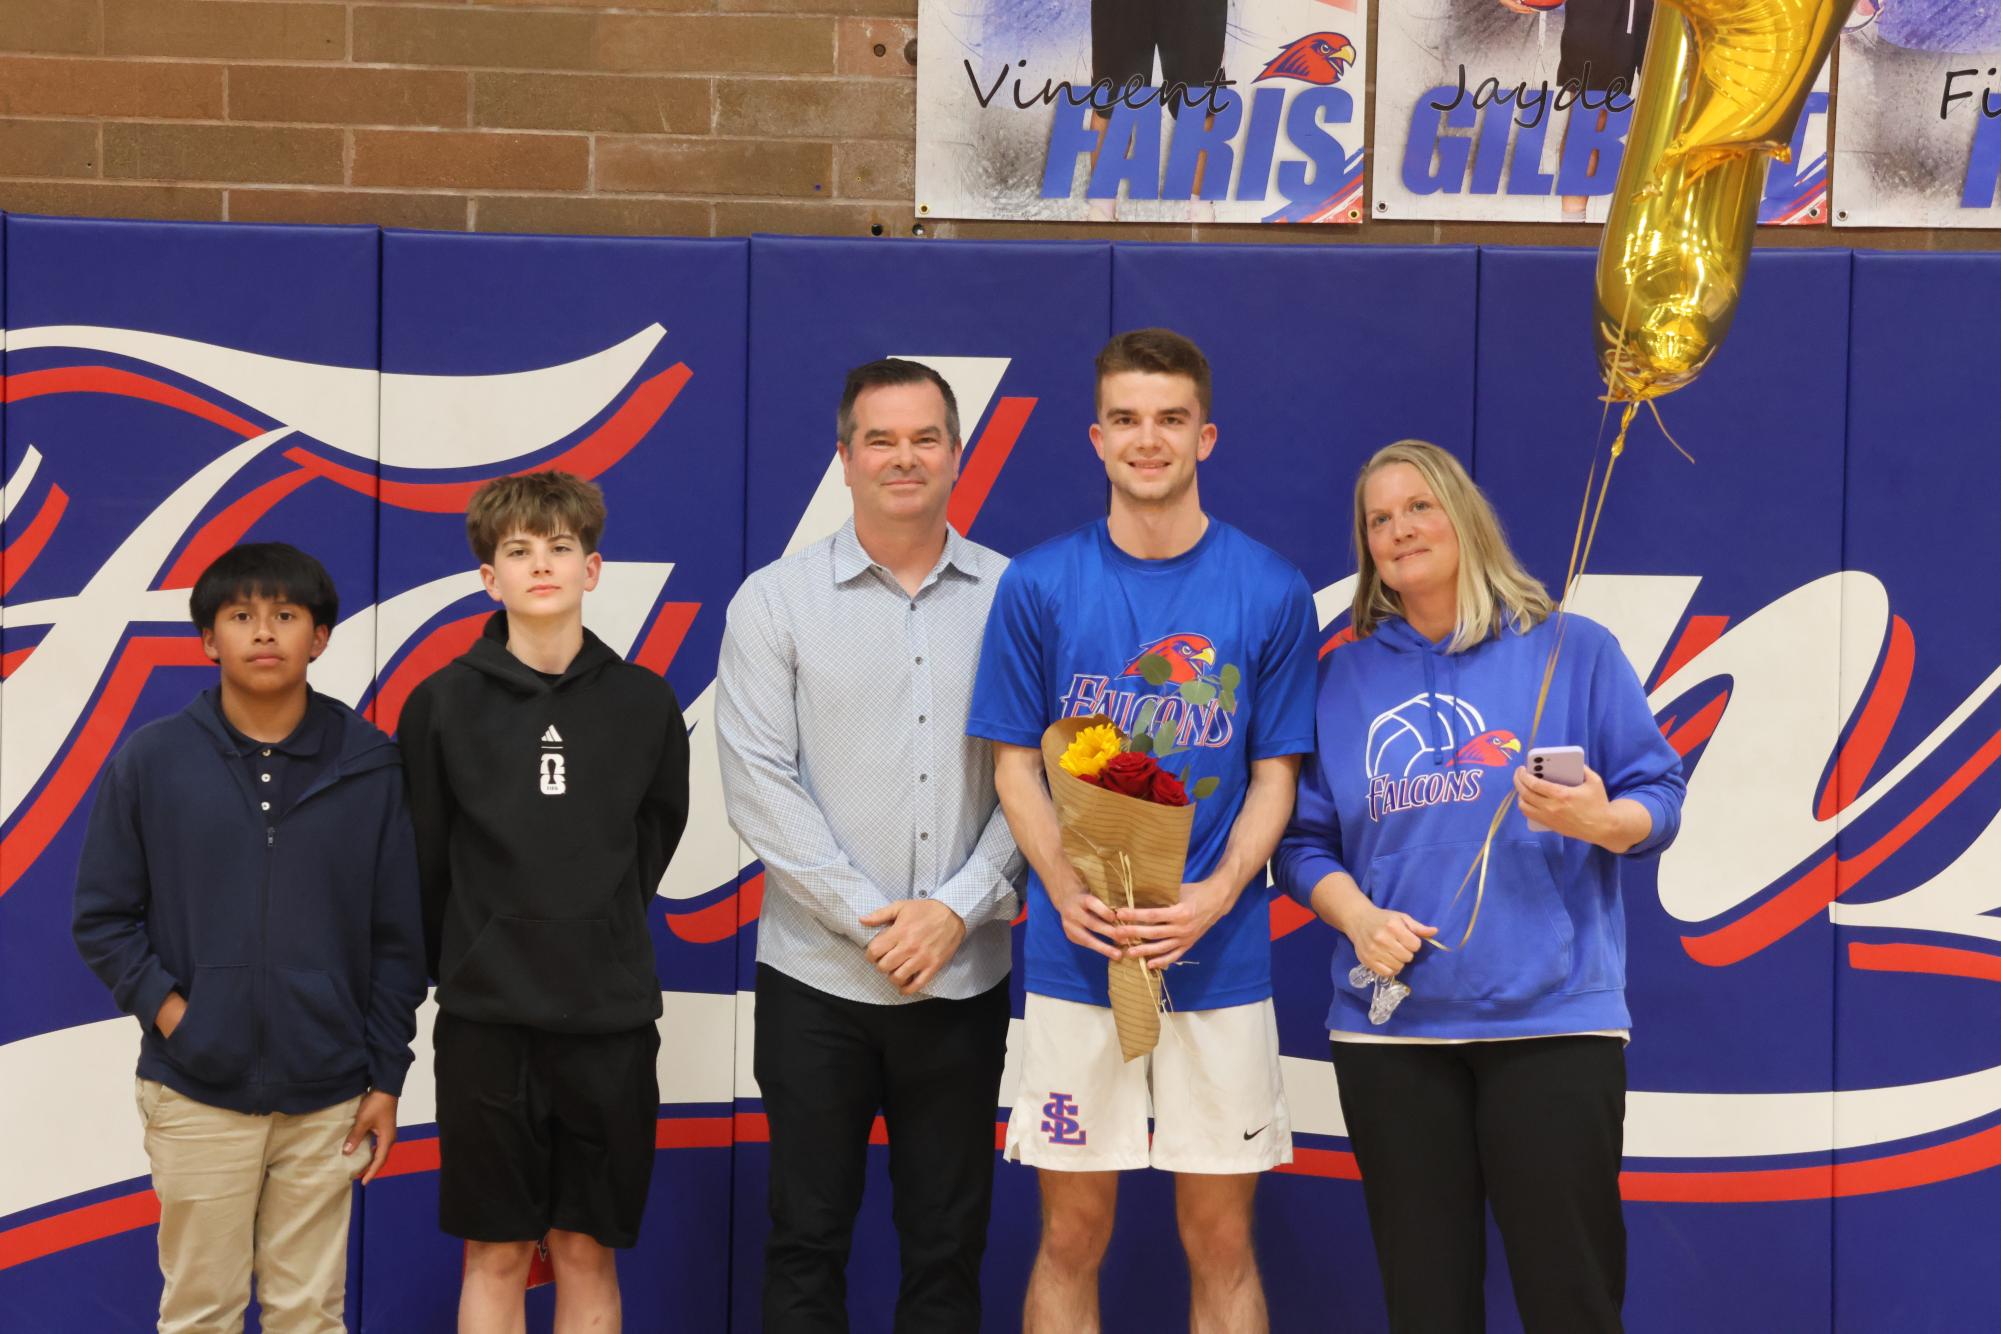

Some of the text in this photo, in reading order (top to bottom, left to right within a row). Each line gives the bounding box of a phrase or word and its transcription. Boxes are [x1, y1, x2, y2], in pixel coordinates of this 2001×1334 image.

[963, 58, 1237, 115] Vincent
[1430, 62, 1637, 129] Jayde
[1040, 86, 1355, 202] FARIS
[1401, 85, 1828, 200] GILBT
[1366, 768, 1484, 823] FALCONS
